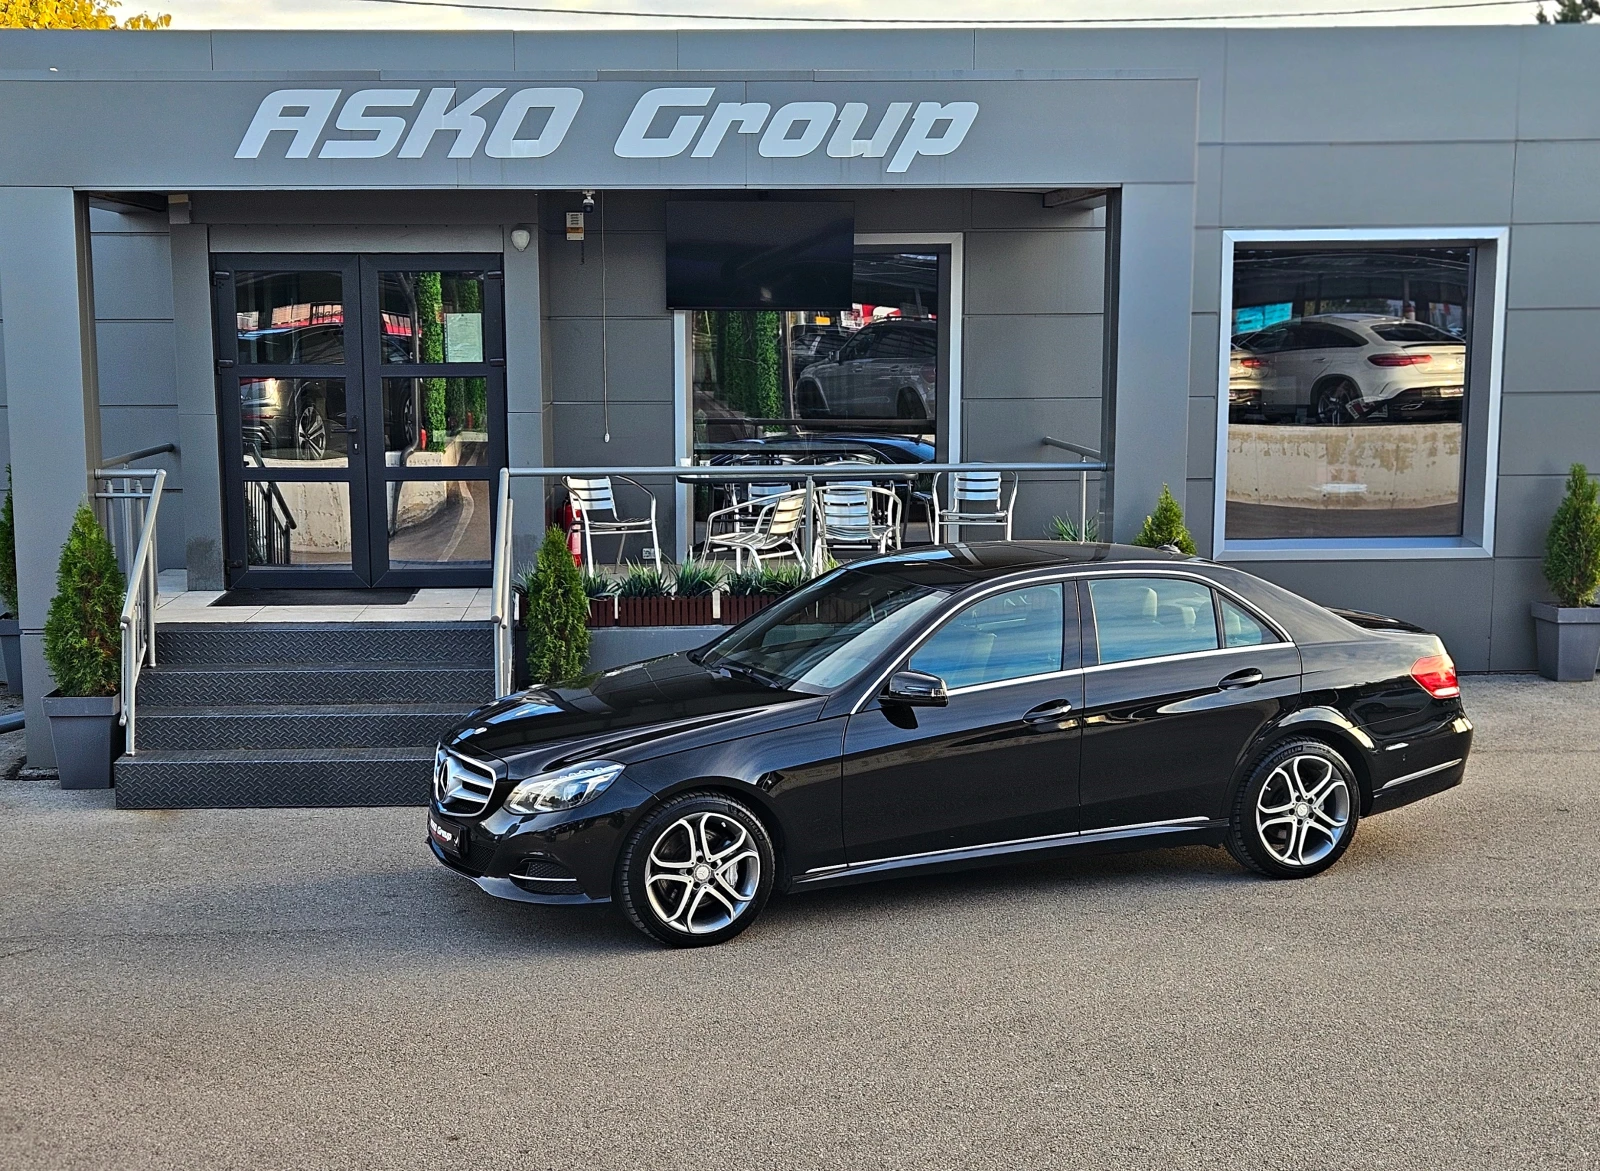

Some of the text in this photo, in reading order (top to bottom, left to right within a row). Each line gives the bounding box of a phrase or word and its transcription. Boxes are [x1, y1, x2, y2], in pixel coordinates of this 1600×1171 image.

[234, 87, 979, 173] ASKO Group
[1273, 745, 1303, 763] MICHELIN
[738, 811, 764, 840] MICHELIN
